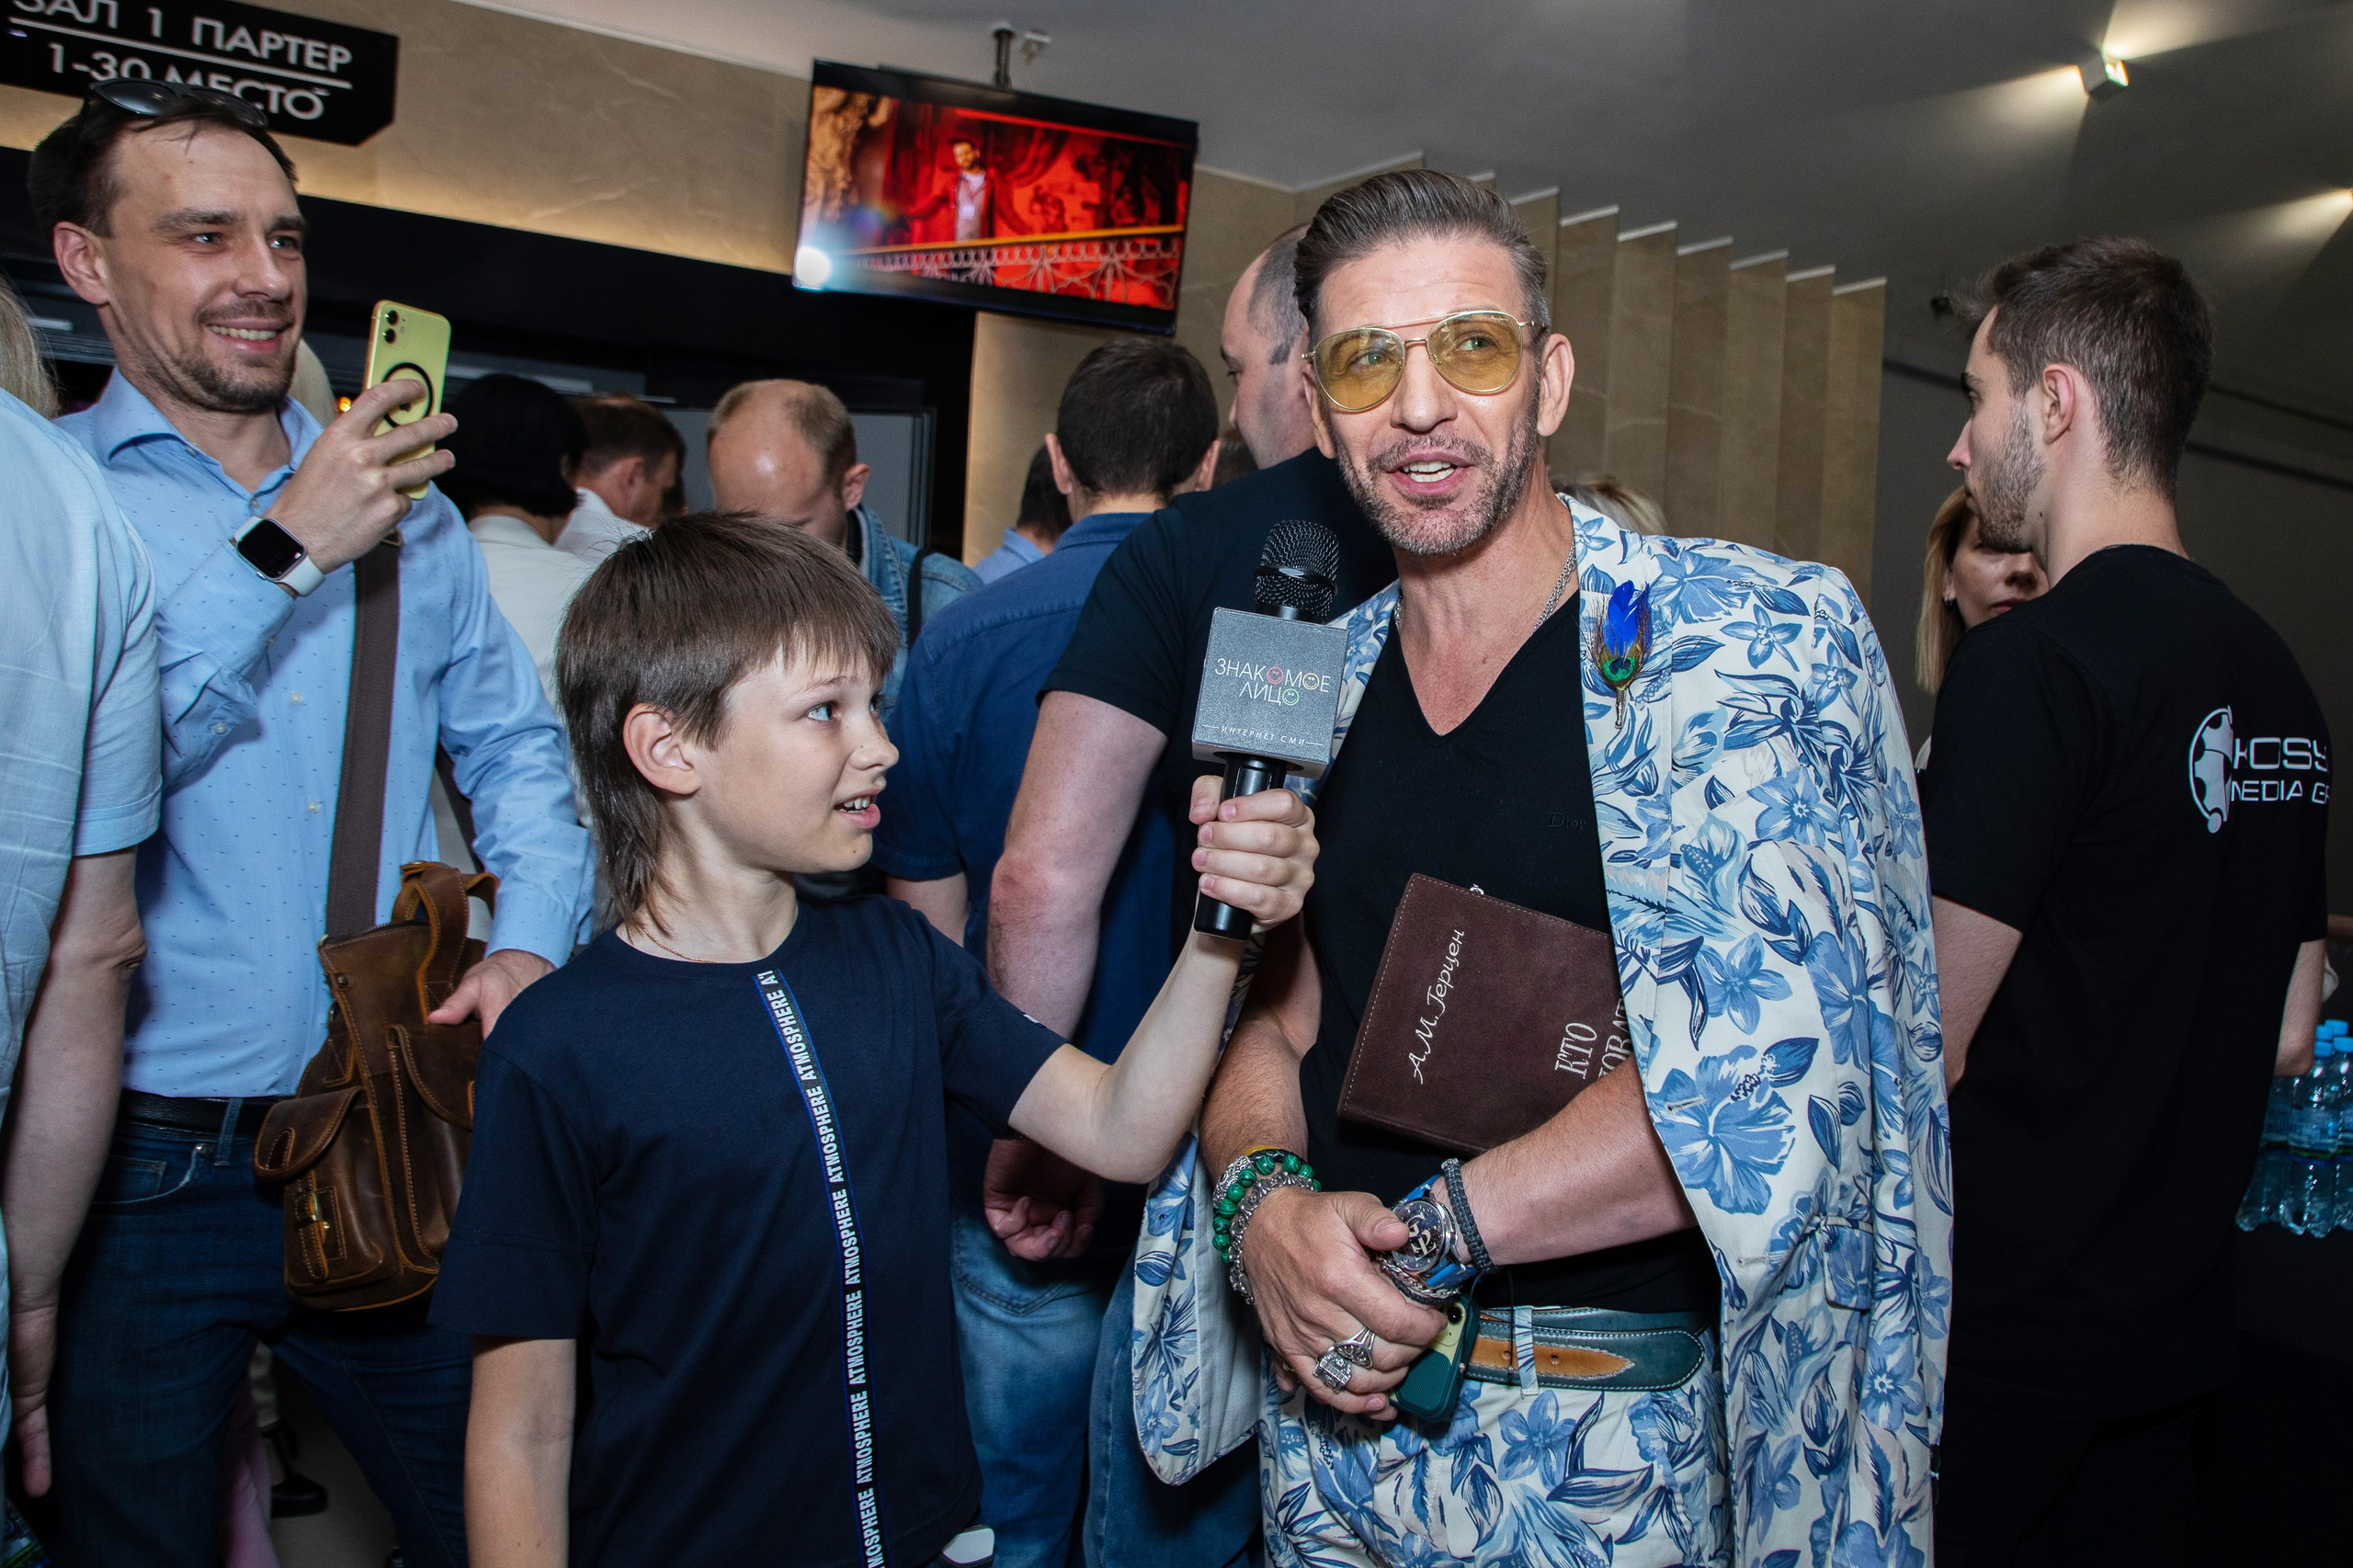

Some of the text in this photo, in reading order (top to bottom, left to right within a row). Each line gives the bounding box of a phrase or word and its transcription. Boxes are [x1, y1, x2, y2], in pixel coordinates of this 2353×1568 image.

[48, 41, 153, 82] 1-30
[147, 6, 163, 38] 1
[191, 16, 353, 73] ПАРТЕР
[1214, 657, 1332, 693] ЗНАКОМОЕ
[1238, 681, 1300, 706] ЛИЦО
[1221, 725, 1305, 746] ИНТЕРНЕТ СМИ
[1547, 811, 1588, 830] Dior
[766, 989, 817, 1081] ATMOSPHERE
[1554, 1022, 1598, 1080] КТО
[805, 1085, 844, 1183] ATMOSPHERE
[832, 1188, 860, 1285] ATMOSPHERE
[846, 1290, 866, 1385] ATMOSPHERE
[850, 1391, 873, 1484] ATMOSPHERE
[858, 1487, 885, 1568] MOSPHERE
